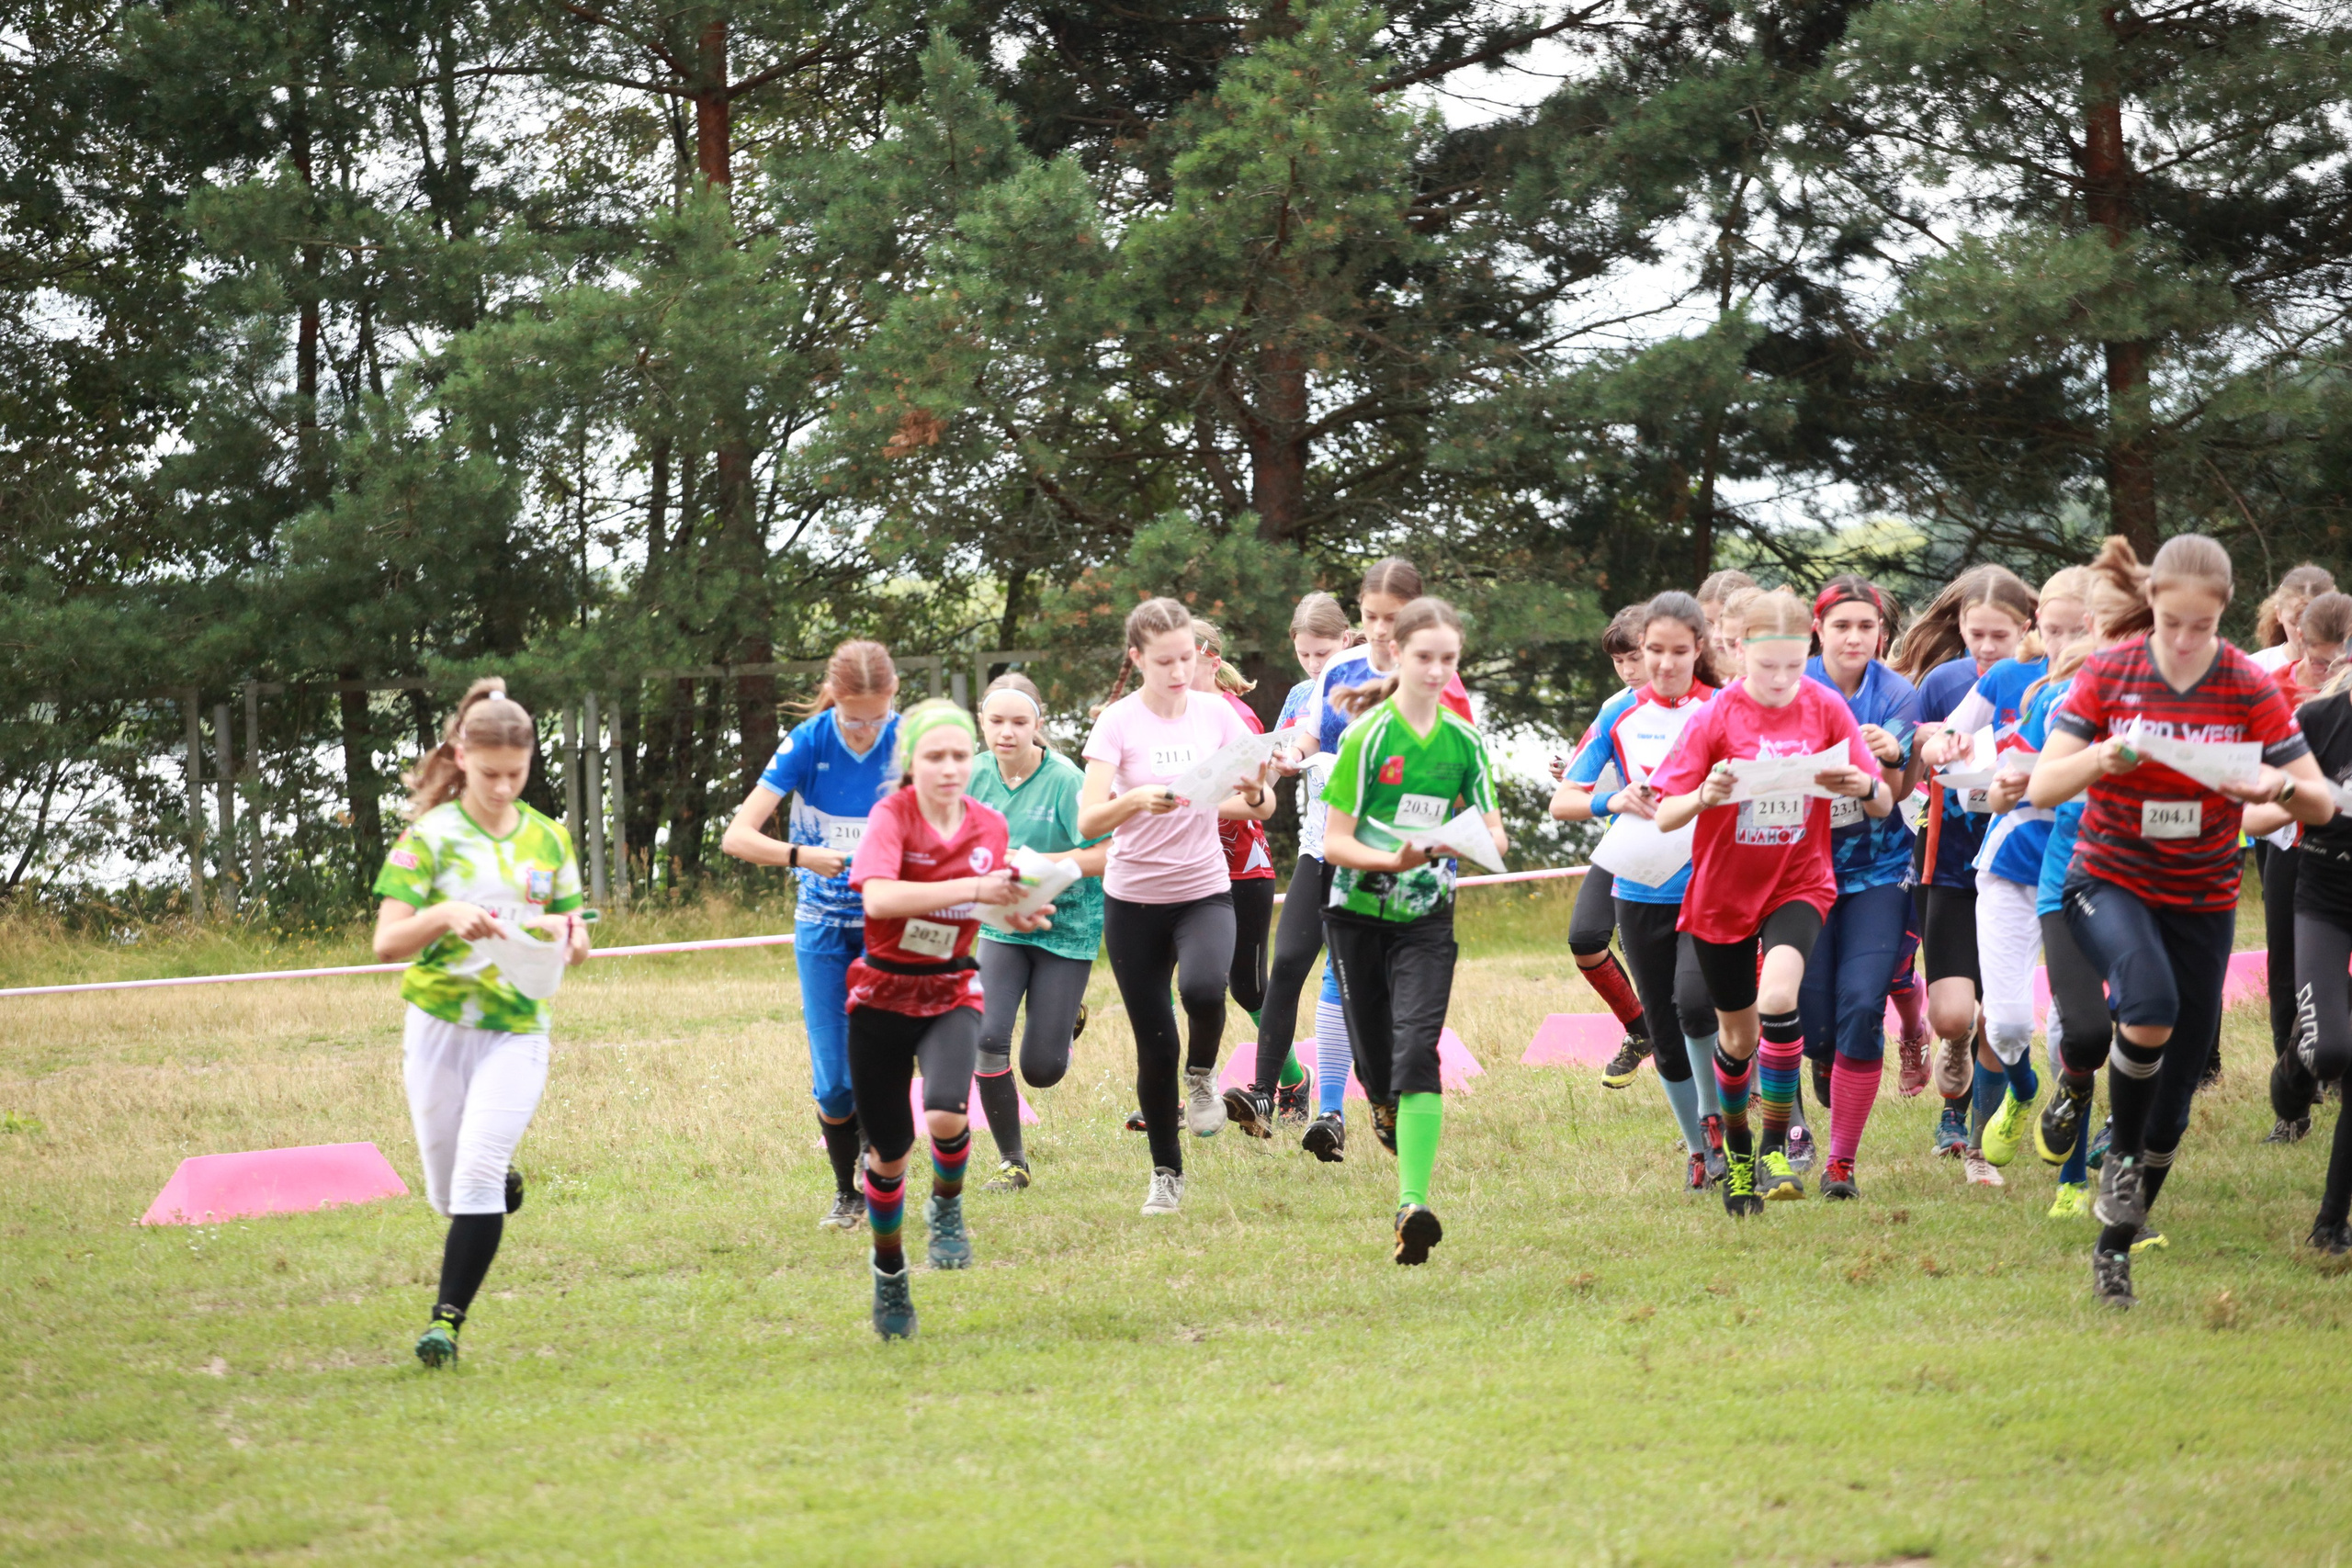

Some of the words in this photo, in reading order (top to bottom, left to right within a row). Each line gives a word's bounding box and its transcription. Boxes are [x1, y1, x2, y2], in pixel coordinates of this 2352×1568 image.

[1155, 750, 1192, 764] 211.1
[1403, 800, 1442, 817] 203.1
[1758, 800, 1798, 815] 213.1
[2149, 807, 2194, 824] 204.1
[910, 925, 952, 946] 202.1
